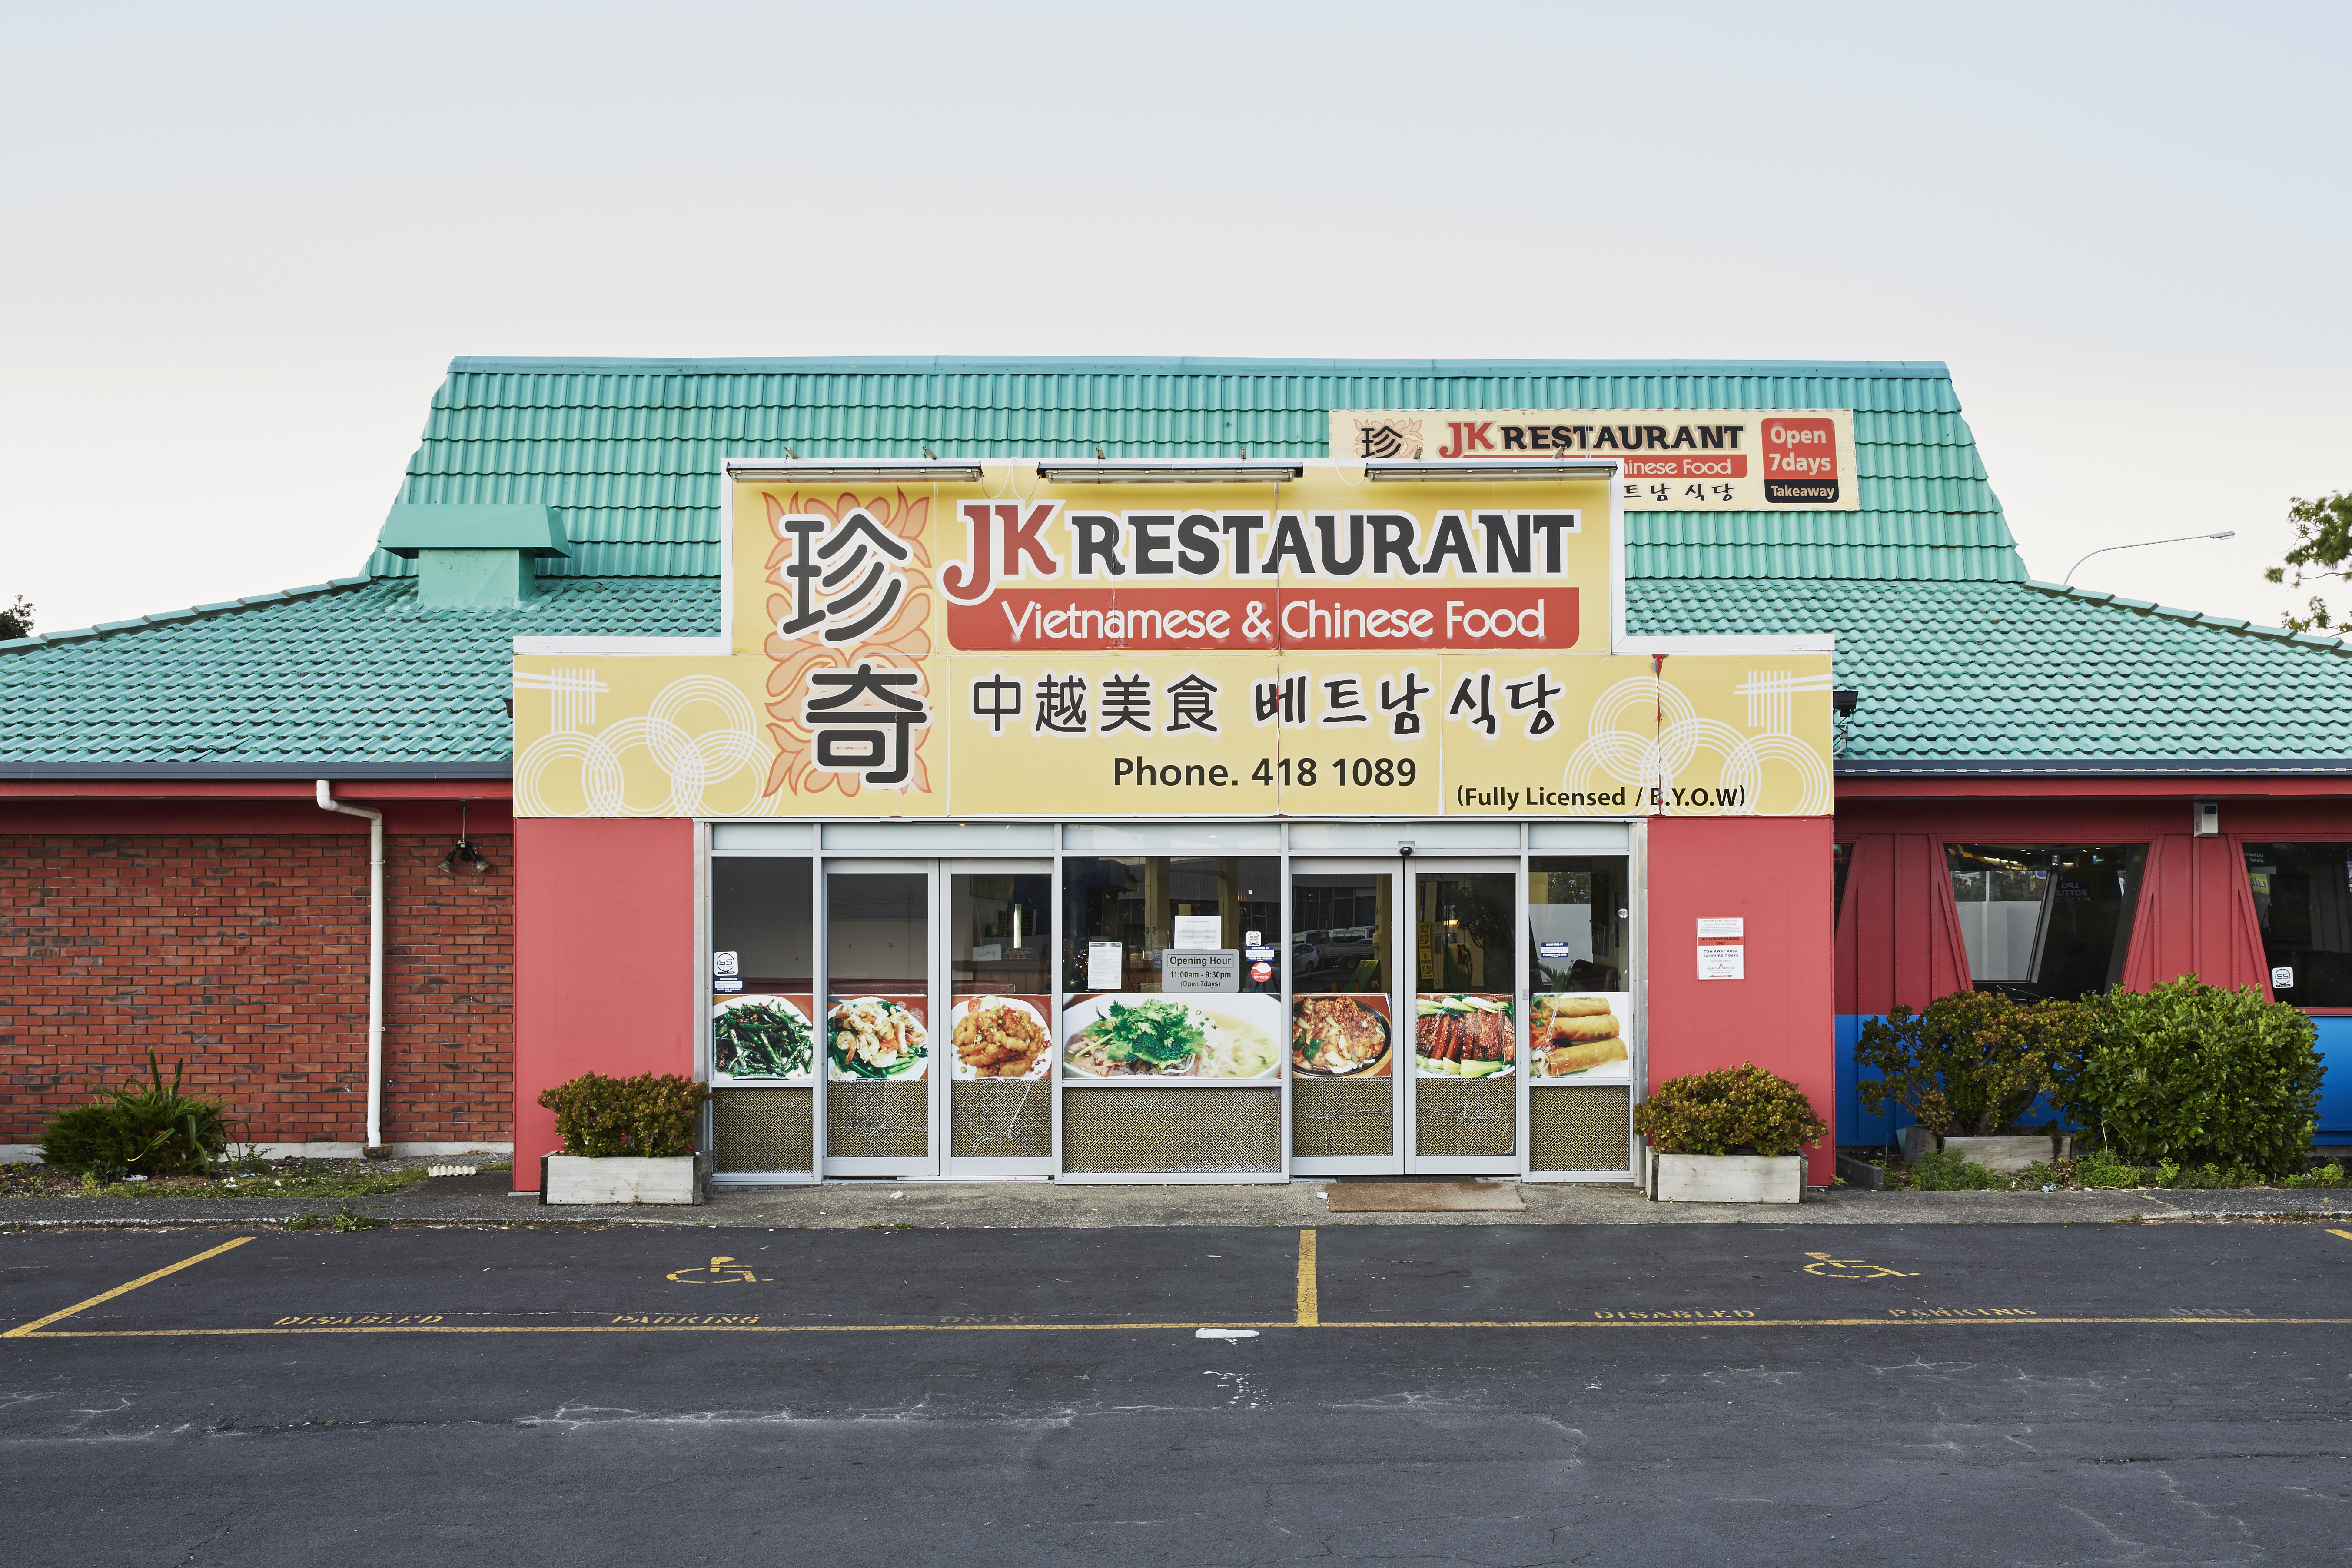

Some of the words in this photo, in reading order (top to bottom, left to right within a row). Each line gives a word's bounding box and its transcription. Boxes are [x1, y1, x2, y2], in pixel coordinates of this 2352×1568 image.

[1439, 423, 1494, 458] JK
[1500, 425, 1743, 450] RESTAURANT
[1771, 426, 1826, 448] Open
[1624, 460, 1677, 474] inese
[1683, 458, 1731, 474] Food
[1769, 452, 1831, 475] 7days
[1685, 483, 1735, 501] 식당
[1771, 485, 1834, 499] Takeaway
[943, 505, 1057, 601] JK
[1071, 515, 1574, 576] RESTAURANT
[1001, 600, 1230, 639] Vietnamese
[1242, 601, 1271, 638] &
[1282, 599, 1433, 638] Chinese
[1447, 598, 1544, 639] Food
[974, 674, 1217, 732] 中越美食
[1256, 673, 1429, 734] 베트남
[1450, 674, 1561, 734] 식당
[1114, 756, 1238, 786] Phone.
[1252, 758, 1317, 787] 418
[1332, 758, 1416, 787] 1089
[1458, 785, 1519, 811] (Fully
[1526, 787, 1625, 806] Licensed
[1170, 956, 1207, 966] Opening
[1210, 956, 1231, 964] Hour
[274, 1316, 443, 1325] DISABLED
[1594, 1310, 1755, 1319] DISABLED
[1888, 1308, 2037, 1316] PARKING
